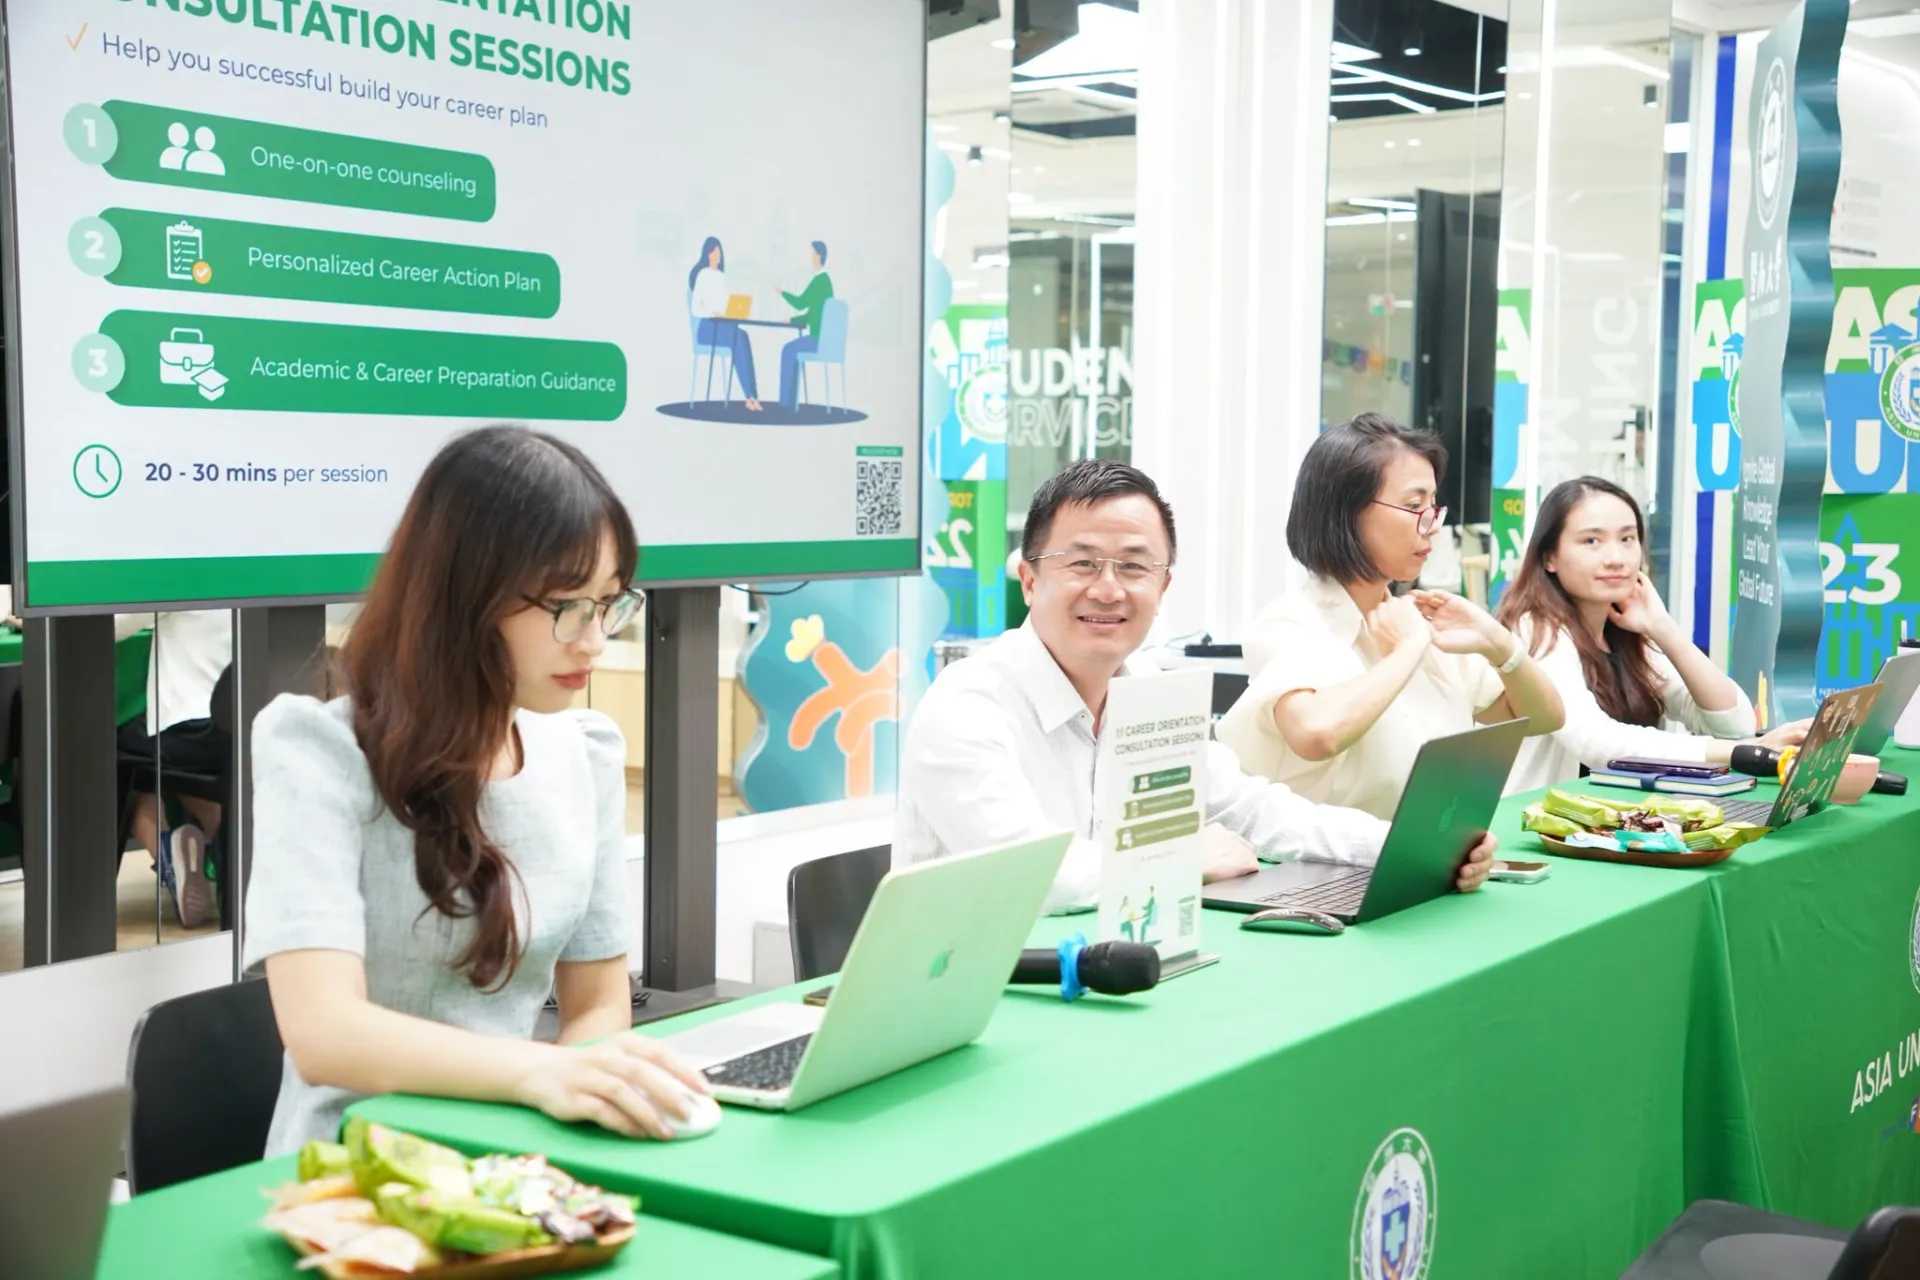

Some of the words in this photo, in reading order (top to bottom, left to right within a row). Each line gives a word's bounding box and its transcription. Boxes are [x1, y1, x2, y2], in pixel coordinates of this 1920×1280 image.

[438, 0, 631, 40] ATION
[112, 0, 436, 61] ULTATION
[449, 28, 631, 96] SESSIONS
[102, 32, 161, 67] Help
[167, 48, 211, 72] you
[218, 58, 332, 93] successful
[339, 74, 391, 103] build
[396, 88, 440, 111] your
[445, 98, 504, 121] career
[509, 105, 549, 128] plan
[82, 117, 97, 148] 1
[250, 145, 374, 181] One-on-one
[377, 165, 477, 198] counseling
[83, 229, 106, 260] 2
[248, 246, 375, 278] Personalized
[379, 259, 439, 283] Career
[443, 265, 500, 289] Action
[504, 271, 541, 293] Plan
[87, 347, 109, 378] 3
[250, 355, 351, 380] Academic
[355, 361, 369, 381] &
[372, 362, 433, 384] Career
[437, 365, 537, 390] Preparation
[540, 370, 616, 393] Guidance
[1007, 347, 1133, 397] UDEN
[144, 462, 172, 482] 20
[192, 462, 220, 482] 30
[226, 462, 278, 482] mins
[283, 466, 314, 487] per
[320, 463, 389, 483] session
[1758, 455, 1776, 485] Global
[1742, 494, 1773, 531] Knowledge
[1742, 531, 1756, 562] Lead
[1755, 535, 1771, 565] Your
[1738, 568, 1755, 600] Global
[1114, 737, 1171, 756] CONSULTATION
[1171, 731, 1205, 746] SESSIONS
[1124, 721, 1156, 737] CAREER
[1157, 715, 1206, 732] ORIENTATION
[1849, 1050, 1893, 1115] ASIA
[1898, 1028, 1920, 1079] UN
